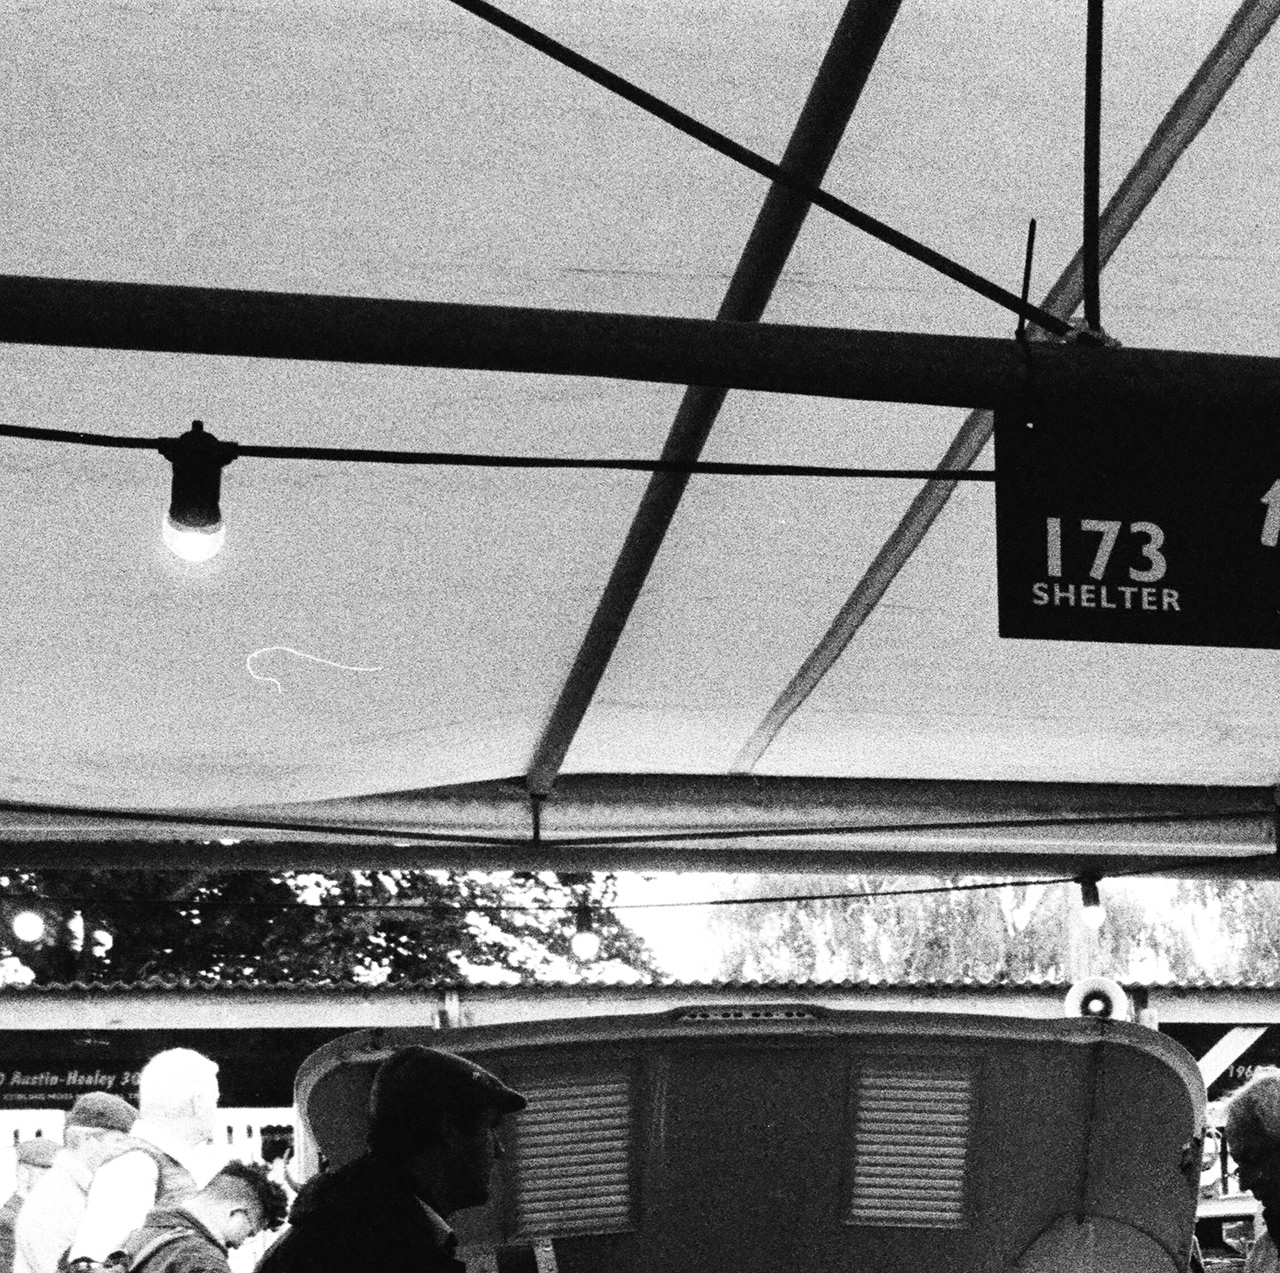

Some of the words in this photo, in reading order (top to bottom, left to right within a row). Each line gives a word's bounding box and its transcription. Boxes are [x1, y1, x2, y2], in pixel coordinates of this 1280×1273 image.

[1047, 518, 1166, 582] 173
[1033, 583, 1180, 611] SHELTER
[11, 1070, 116, 1089] Austin-Healey
[121, 1071, 140, 1086] 30
[1228, 1065, 1255, 1078] 196
